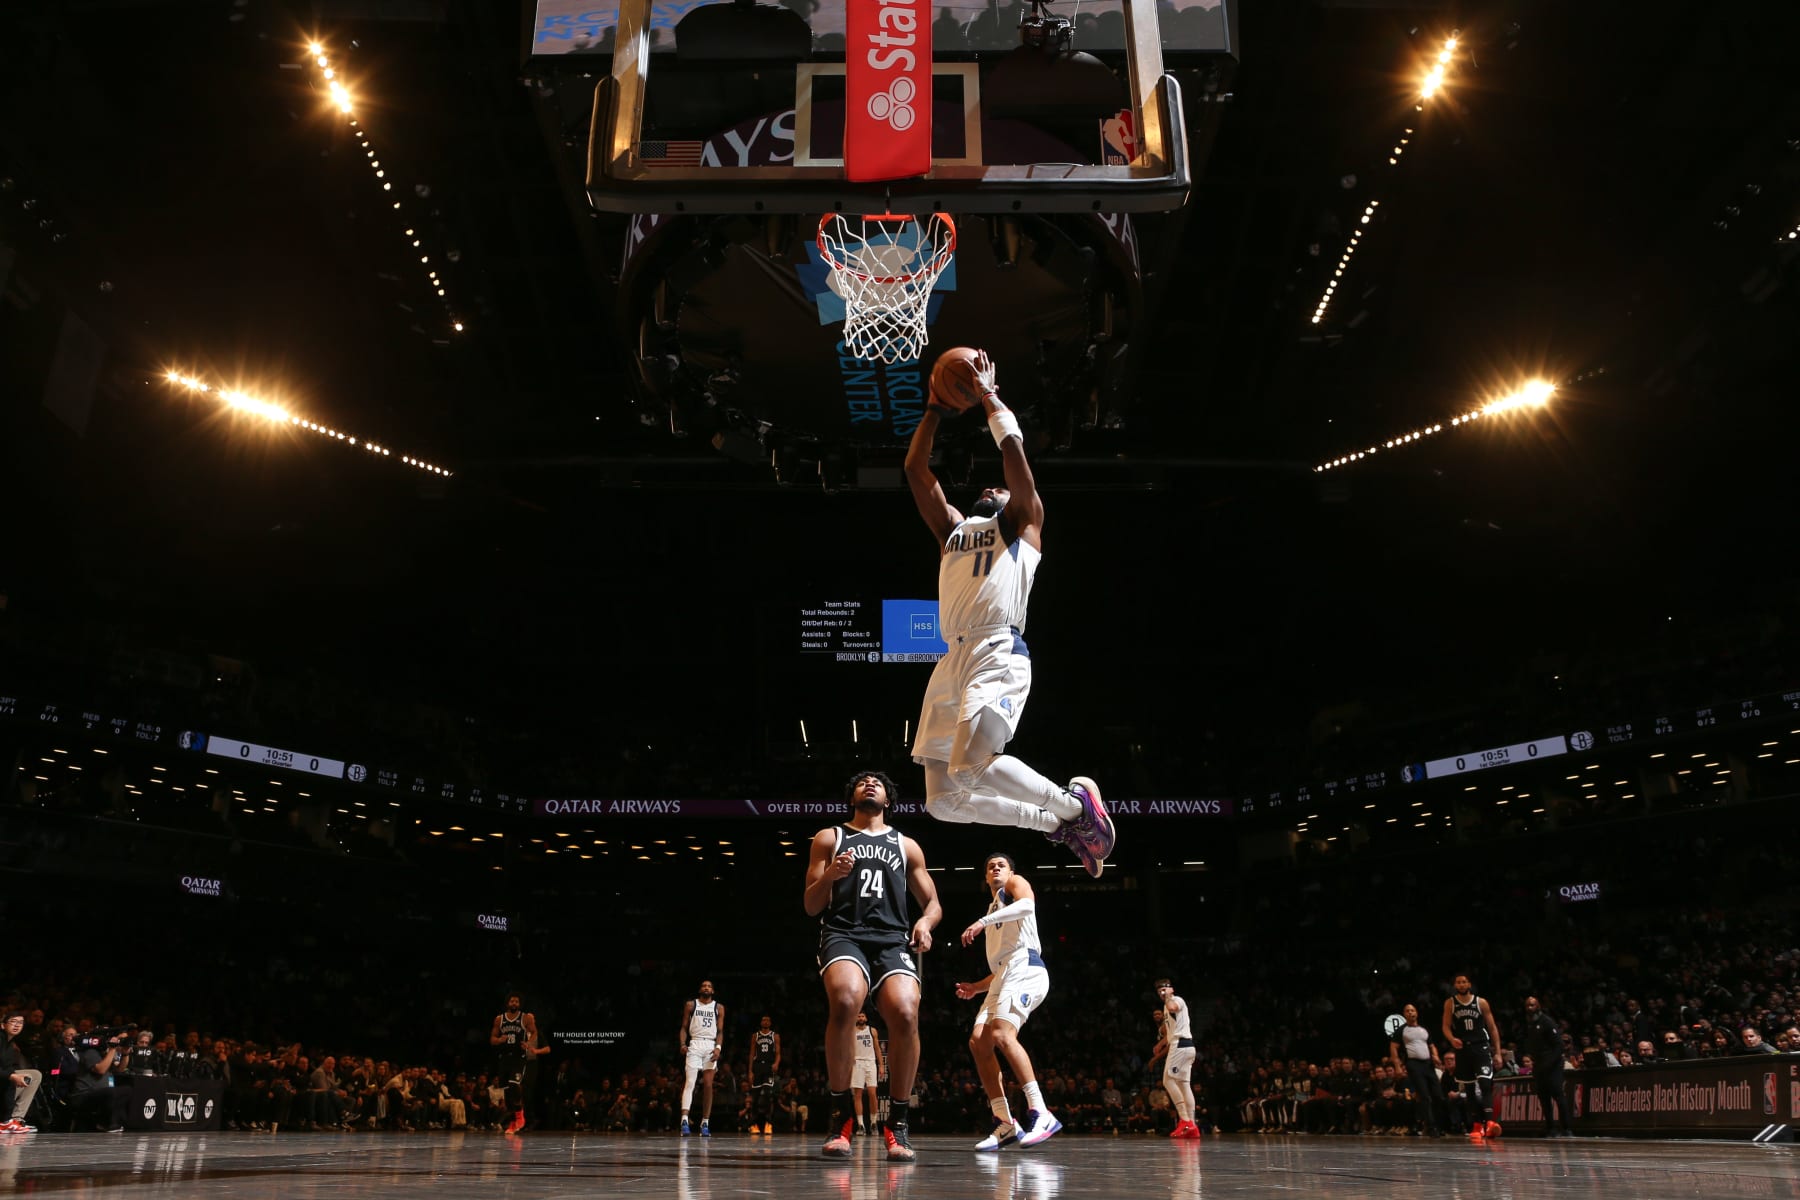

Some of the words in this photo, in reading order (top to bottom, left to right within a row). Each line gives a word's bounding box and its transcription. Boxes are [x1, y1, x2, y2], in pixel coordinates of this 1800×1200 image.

[972, 551, 993, 577] 11
[914, 622, 933, 630] HSS
[836, 652, 866, 662] BROOKLYN
[240, 744, 250, 758] 0
[266, 749, 294, 763] 10:51
[310, 758, 319, 771] 0
[1456, 758, 1466, 770] 0
[1481, 749, 1509, 762] 10:51
[1528, 744, 1538, 757] 0
[545, 799, 602, 814] QATAR
[609, 799, 681, 814] AIRWAYS
[767, 803, 800, 813] OVER
[804, 803, 823, 813] 170
[1149, 800, 1221, 814] AIRWAYS
[842, 844, 902, 871] ROOKLYN
[181, 876, 221, 890] QATAR
[860, 868, 884, 899] 24
[1560, 882, 1600, 898] QATAR
[477, 914, 508, 926] QATAR
[702, 1018, 713, 1028] 55
[1464, 1018, 1474, 1031] 10
[1589, 1087, 1604, 1113] NBA
[1606, 1085, 1652, 1113] Celebrates
[1653, 1082, 1679, 1111] Black
[1680, 1081, 1715, 1115] History
[1718, 1080, 1752, 1110] Month
